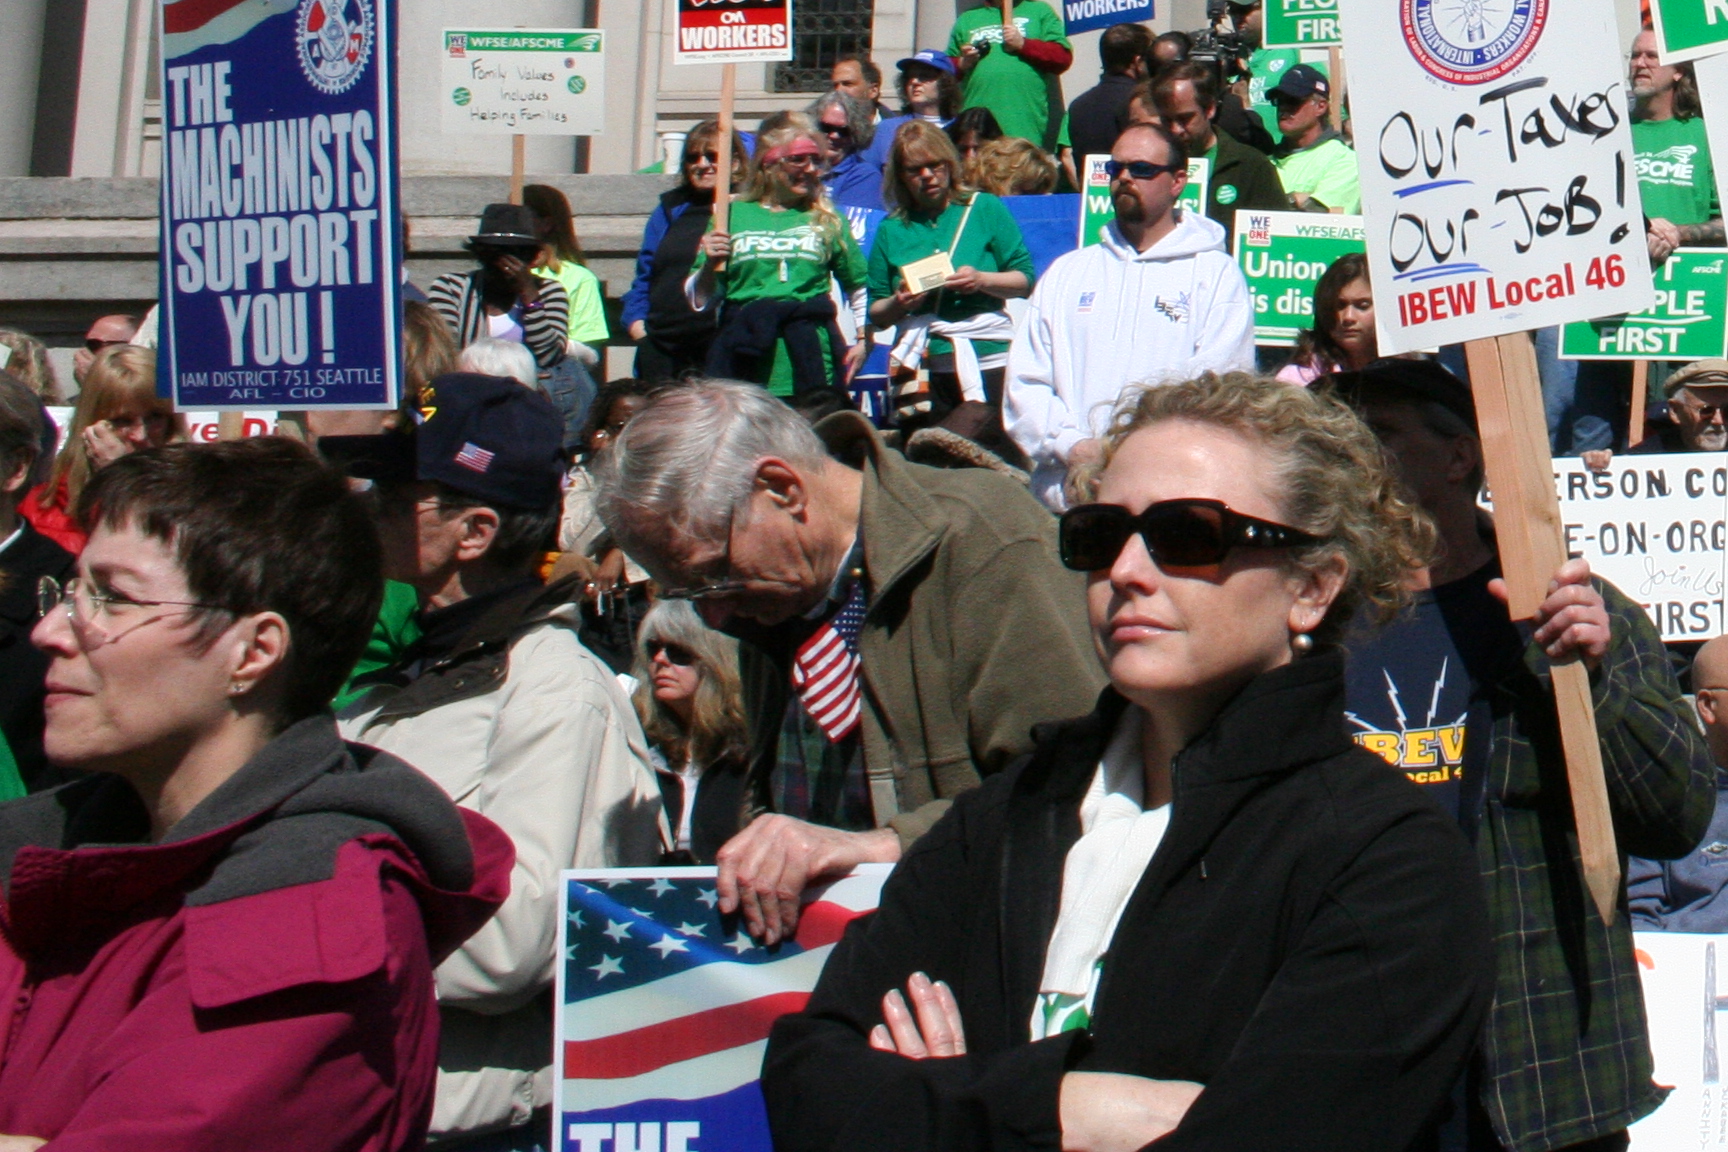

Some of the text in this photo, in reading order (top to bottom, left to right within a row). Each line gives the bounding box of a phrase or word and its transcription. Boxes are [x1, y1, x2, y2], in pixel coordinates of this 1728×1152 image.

[720, 10, 746, 24] on
[470, 37, 565, 48] WFSE/AFSCME
[681, 23, 786, 50] WORKERS
[1418, 4, 1474, 65] INTERNATIONAL
[1484, 15, 1526, 60] WORKERS
[471, 58, 555, 84] Family Values
[168, 60, 233, 127] THE
[470, 107, 568, 126] Helping Families
[171, 110, 376, 220] MACHINISTS
[1250, 216, 1271, 227] WE
[1250, 230, 1269, 239] ONE
[176, 210, 378, 294] SUPPORT
[1245, 251, 1327, 280] Union
[1398, 280, 1477, 327] IBEW
[1486, 262, 1576, 311] Local
[1585, 253, 1626, 290] 46
[220, 292, 310, 367] YOU
[1599, 328, 1686, 353] FIRST
[182, 368, 382, 388] IAM DISTRICT 751 SEATTLE
[229, 387, 326, 399] AFL CIO
[1640, 556, 1691, 596] Join
